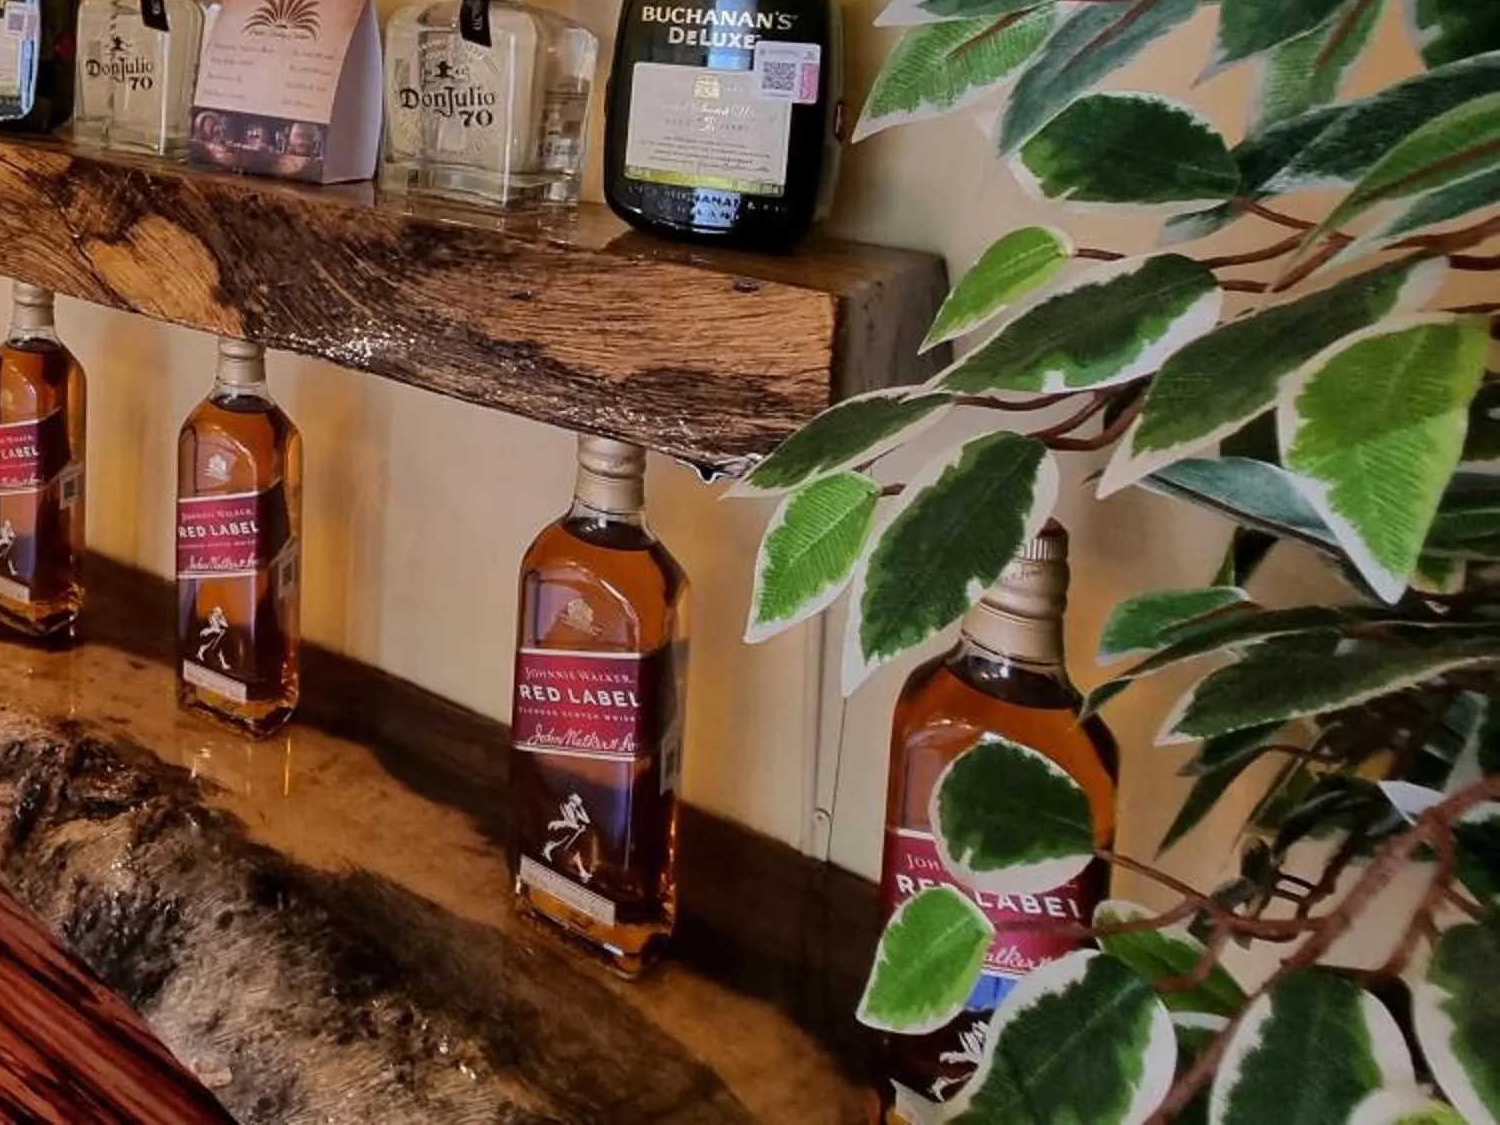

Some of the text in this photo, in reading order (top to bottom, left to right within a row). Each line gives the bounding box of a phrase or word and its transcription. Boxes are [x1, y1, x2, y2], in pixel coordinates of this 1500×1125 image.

[641, 5, 794, 31] BUCHANAN'S
[128, 76, 153, 91] 70
[459, 108, 493, 127] 70
[1, 445, 39, 460] LABEL
[178, 520, 259, 539] RED LABEL
[519, 683, 640, 708] RED LABEL
[975, 890, 1082, 919] LABEL
